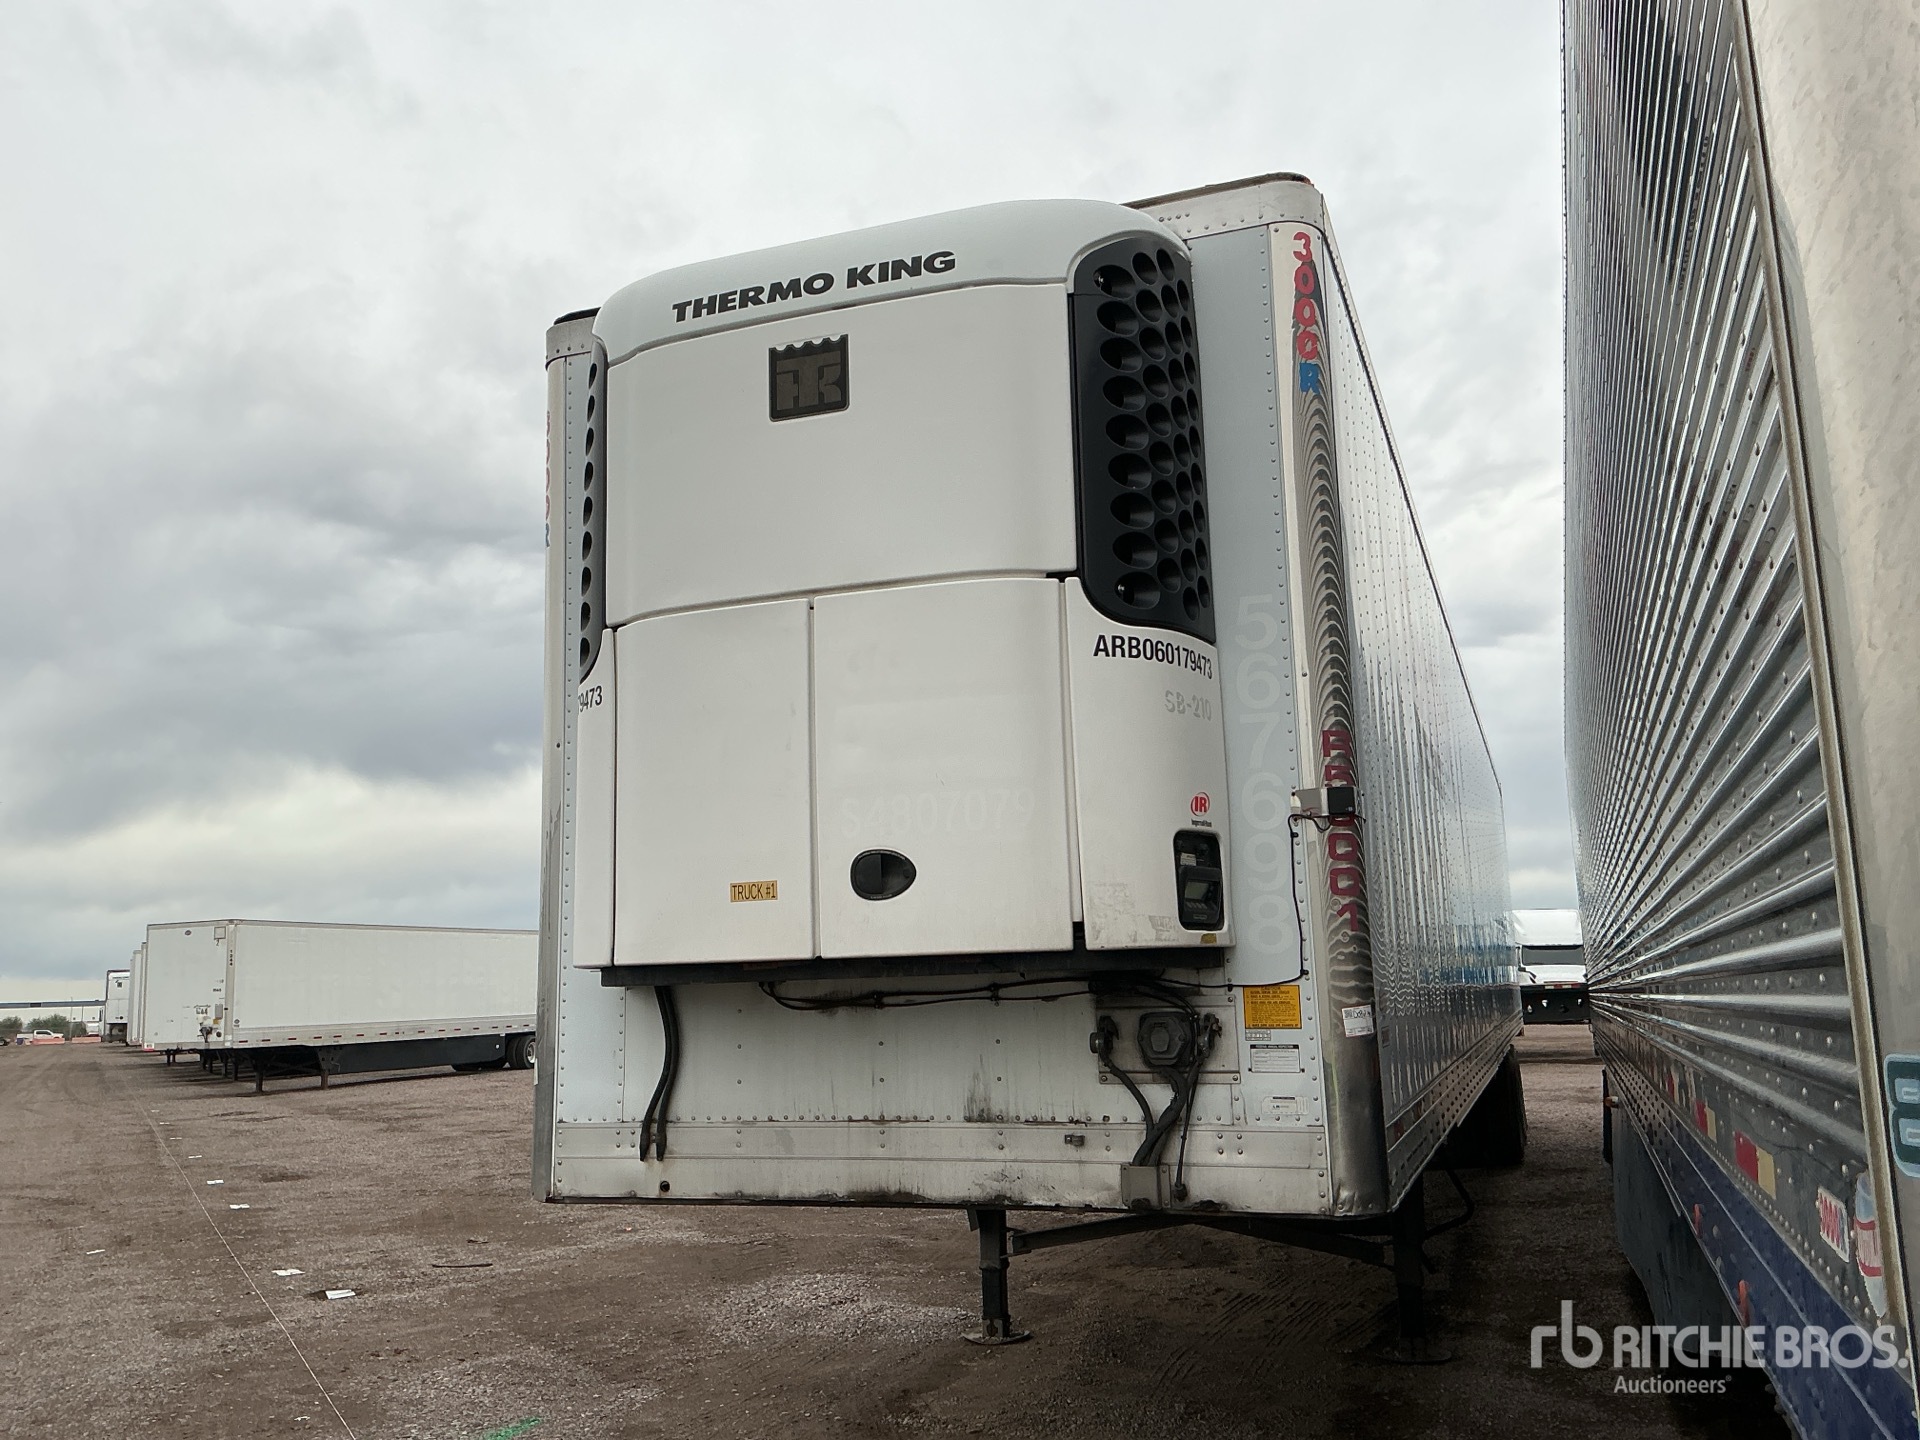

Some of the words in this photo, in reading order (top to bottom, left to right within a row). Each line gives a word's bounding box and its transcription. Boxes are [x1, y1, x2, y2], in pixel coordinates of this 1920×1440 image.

[673, 272, 834, 323] THERMO
[846, 250, 956, 290] KING
[1293, 231, 1320, 394] 3000R
[1093, 634, 1213, 680] ARB060179473
[731, 883, 764, 900] TRUCK
[765, 882, 776, 898] #1
